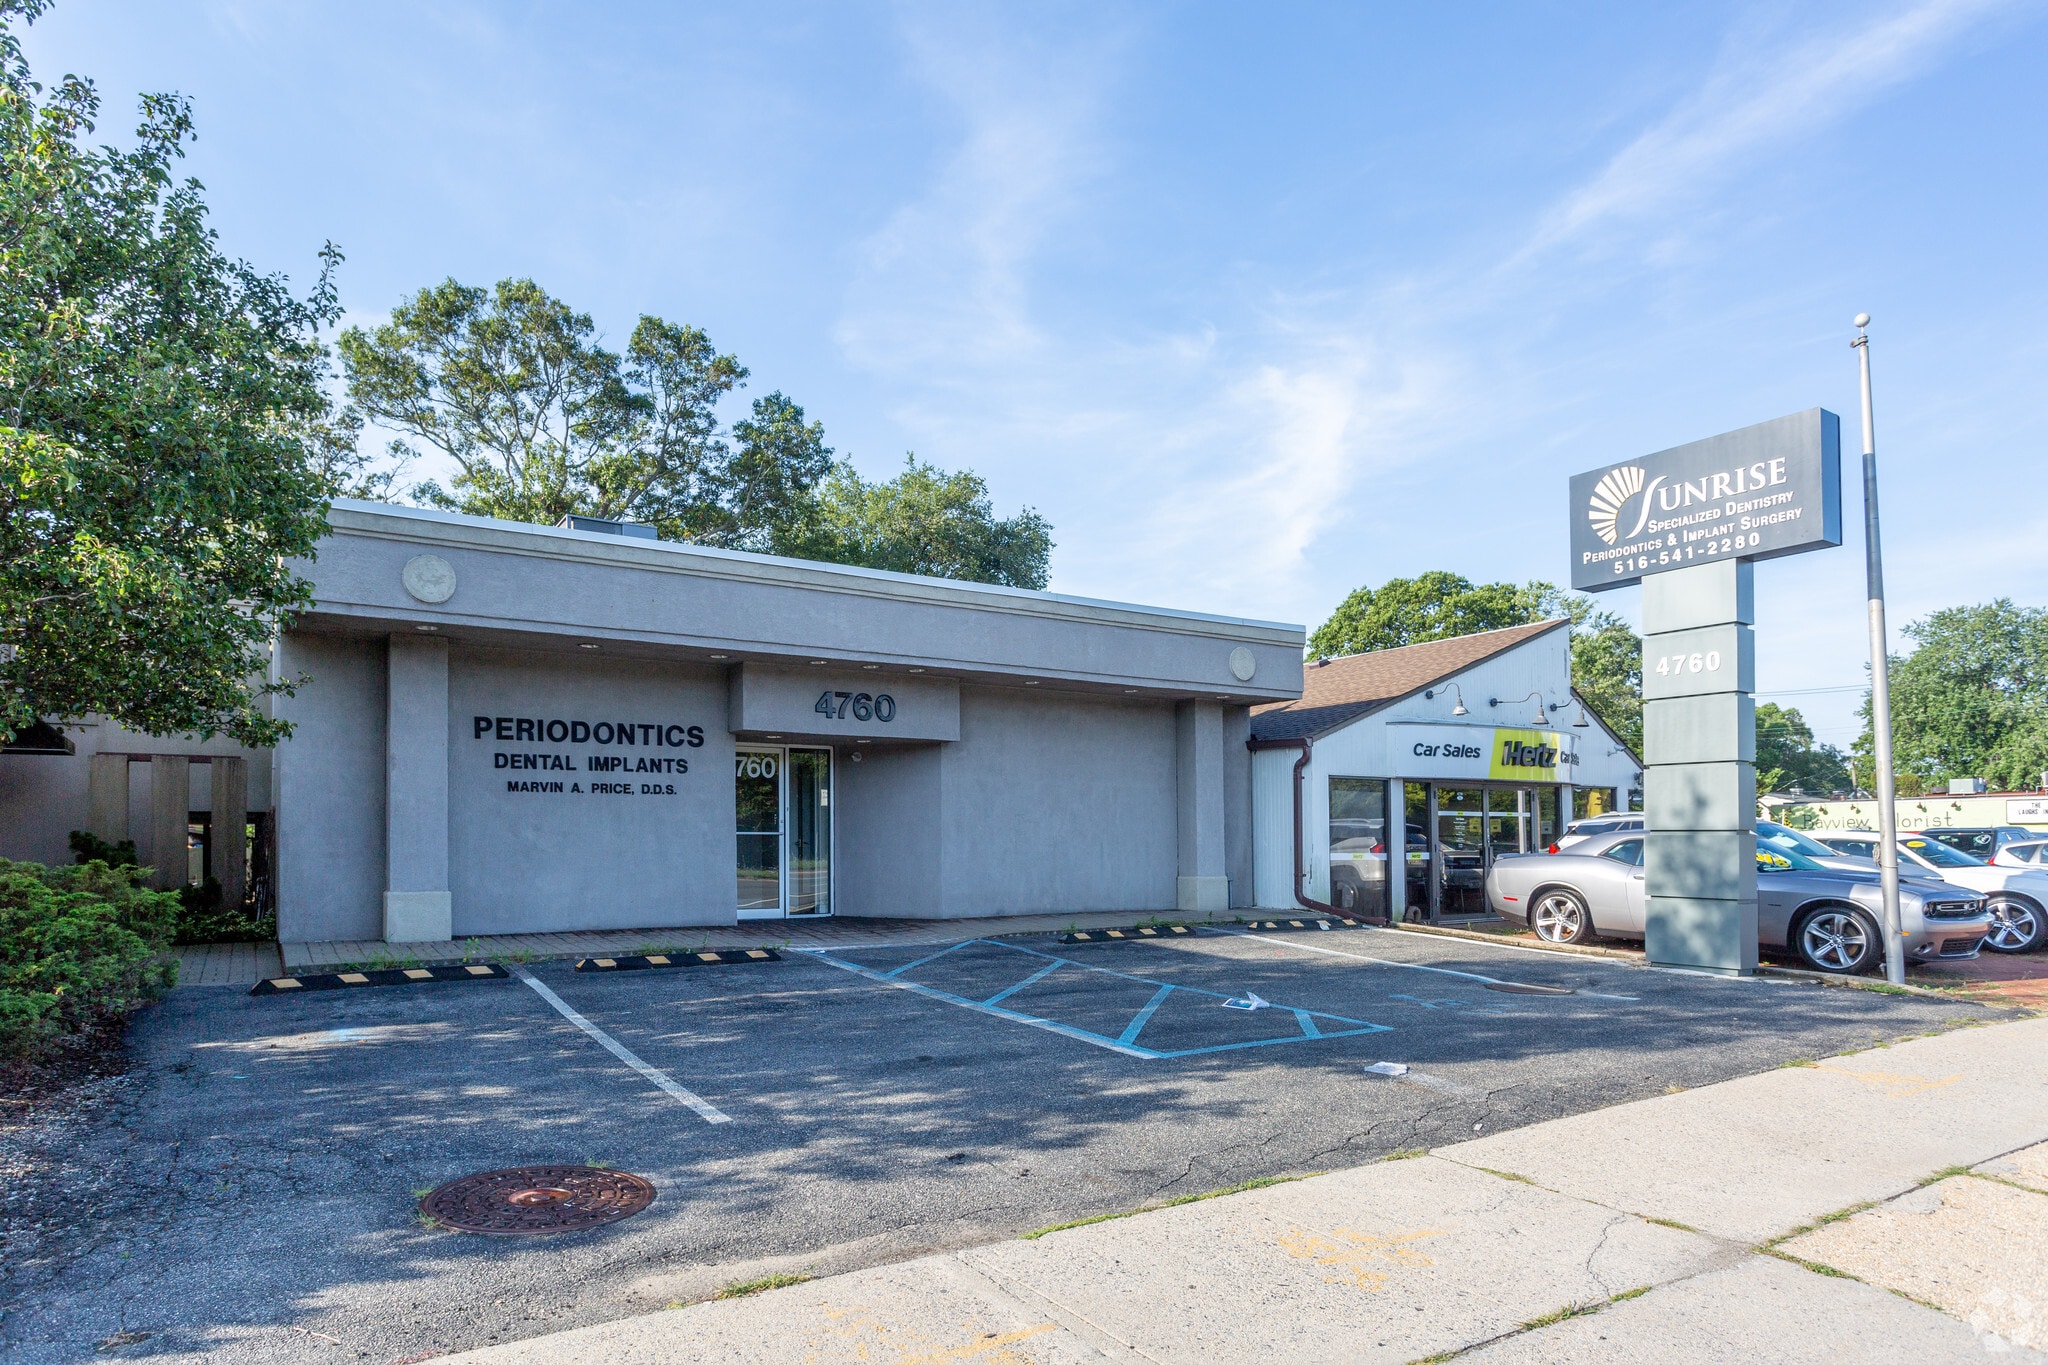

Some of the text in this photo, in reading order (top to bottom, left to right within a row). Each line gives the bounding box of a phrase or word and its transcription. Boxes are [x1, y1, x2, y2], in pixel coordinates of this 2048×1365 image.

[1625, 456, 1788, 539] SUNRISE
[1648, 491, 1794, 534] SPECIALIZED DENTISTRY
[1583, 508, 1802, 564] PERIODONTICS & IMPLANT SURGERY
[1614, 532, 1760, 574] 516-541-2280
[1656, 651, 1721, 676] 4760
[815, 691, 896, 722] 4760
[473, 716, 704, 748] PERIODONTICS
[494, 753, 688, 774] DENTAL IMPLANTS
[1413, 743, 1481, 759] Car Sales
[1501, 741, 1557, 768] Hertz
[735, 756, 776, 779] 760
[507, 781, 677, 796] MARVIN A. PRICE, D.D.S.
[1802, 811, 1954, 831] Bayview lorist
